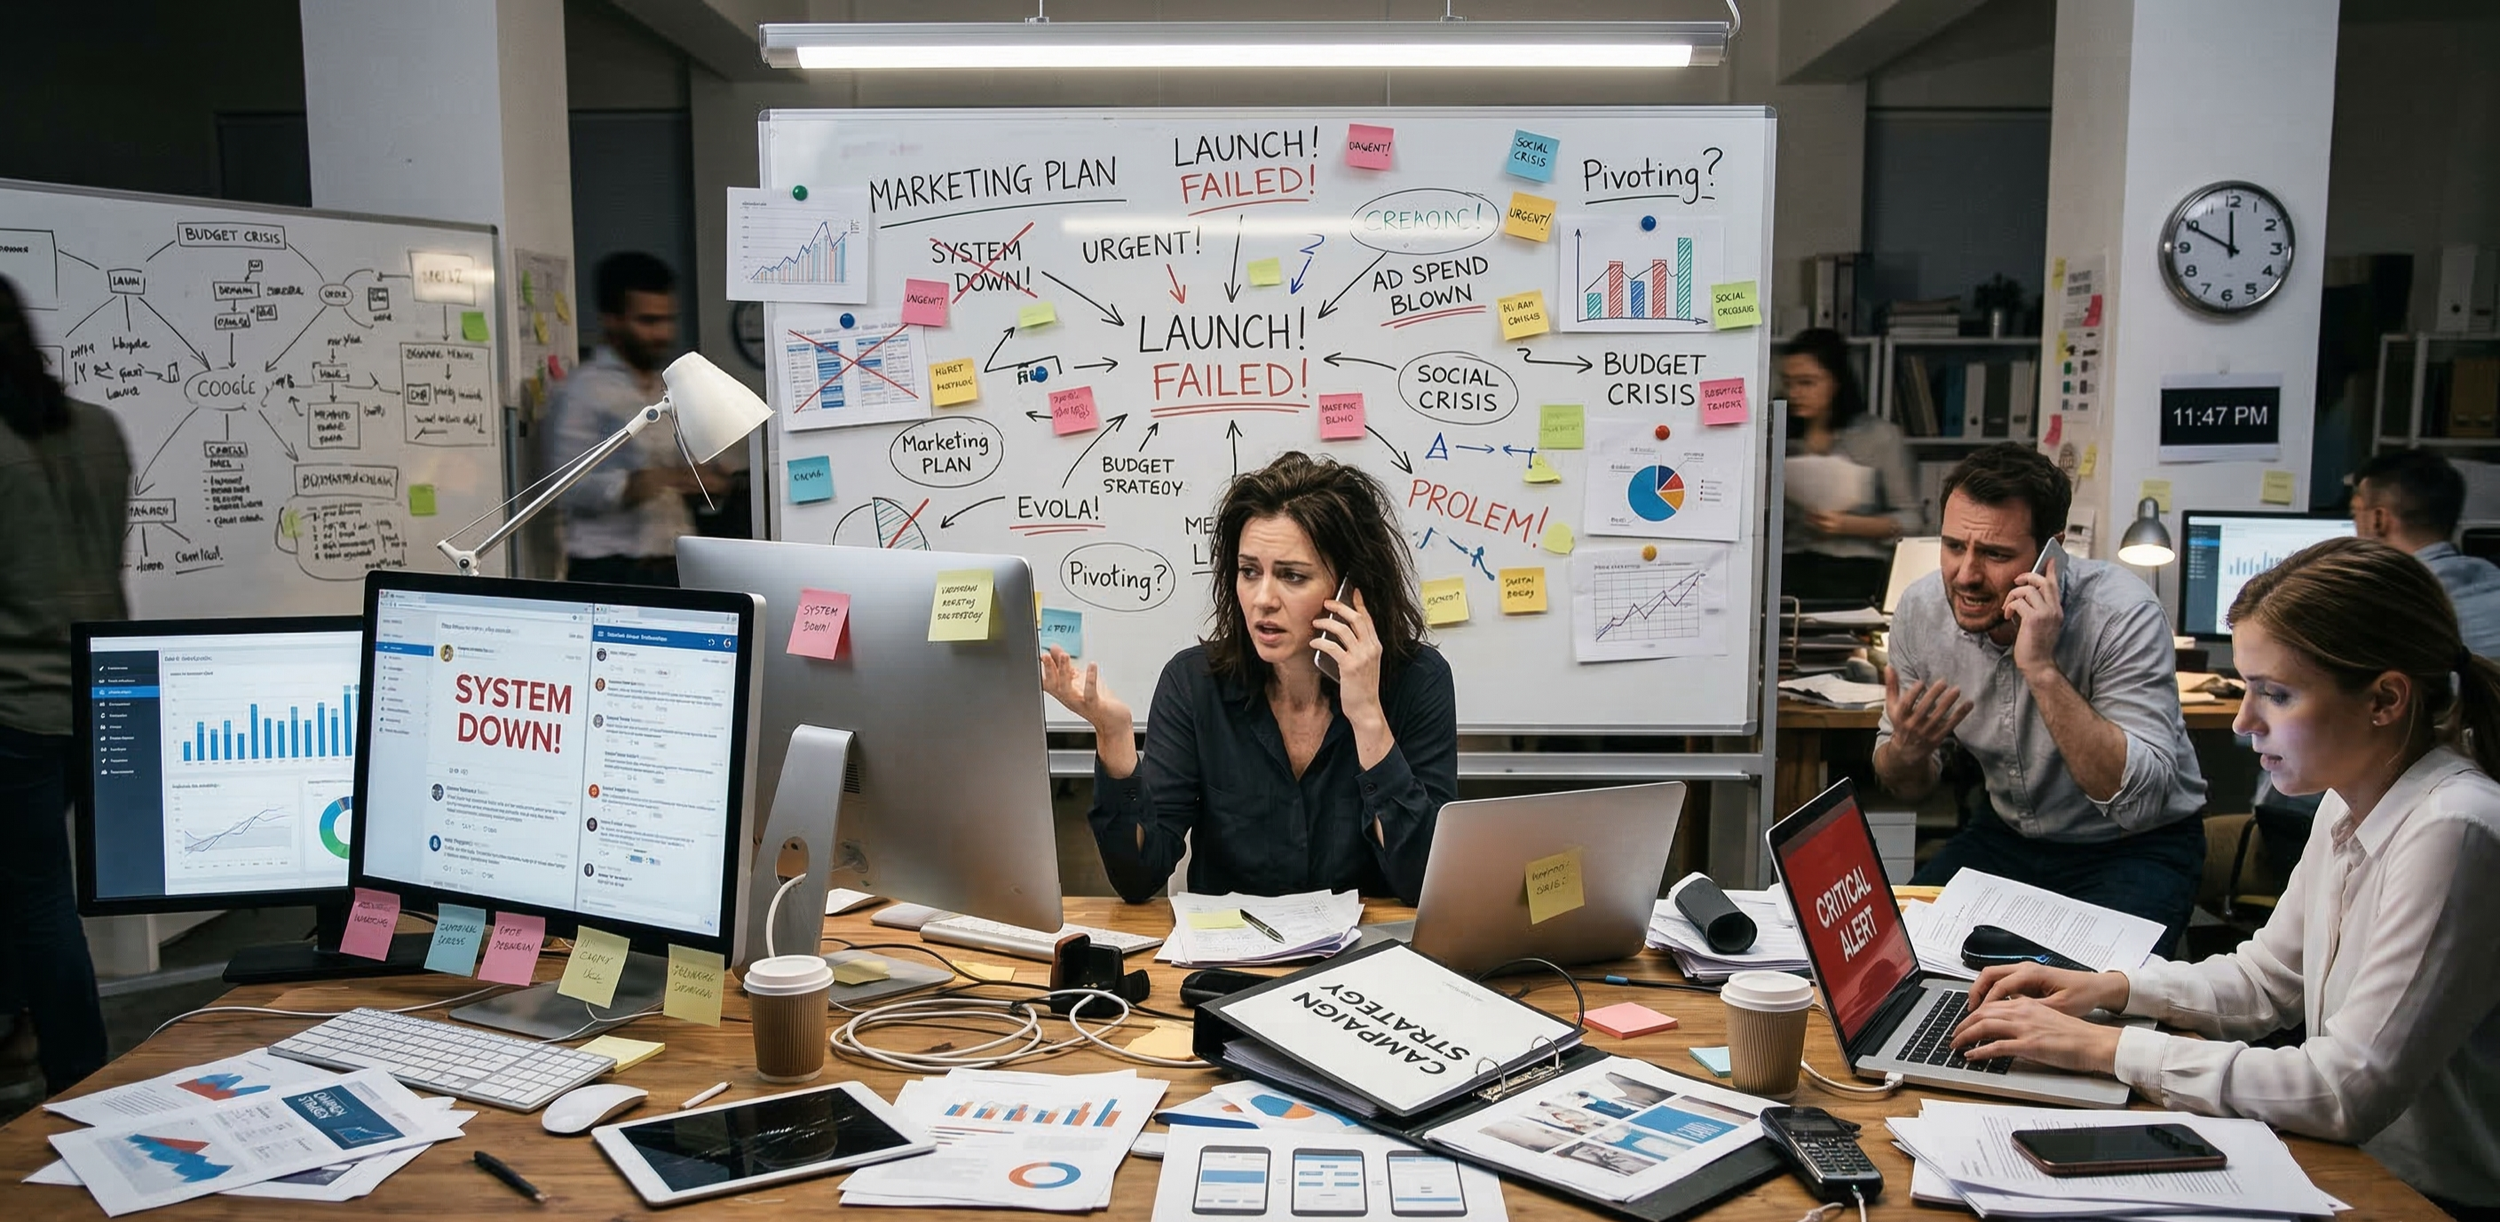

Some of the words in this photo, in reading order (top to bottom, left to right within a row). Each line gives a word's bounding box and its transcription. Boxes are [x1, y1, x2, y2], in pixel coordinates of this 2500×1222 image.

[1175, 125, 1319, 168] LAUNCH!
[1515, 136, 1548, 155] SOCIAL
[1513, 151, 1546, 168] CRISIS
[869, 163, 1033, 214] MARKETING
[1045, 156, 1118, 192] PLAN
[1181, 164, 1317, 203] FAILED!
[1583, 147, 1724, 205] Pivoting?
[2226, 195, 2241, 208] 12
[1509, 207, 1552, 231] URGENT!
[2264, 219, 2278, 231] 2
[185, 227, 238, 241] BUDGET
[244, 232, 281, 244] CRISIS
[1082, 226, 1202, 264] URGENT!
[2178, 242, 2191, 253] 9
[931, 241, 1022, 264] SYSTEM
[2269, 243, 2282, 255] 3
[955, 267, 1031, 293] DOWN!
[1372, 268, 1404, 292] AD
[1413, 255, 1490, 287] SPEND
[2184, 265, 2197, 277] 8
[2262, 265, 2273, 276] 4
[1391, 283, 1473, 316] BLOWN
[1715, 292, 1745, 304] SOCIAL
[2201, 283, 2211, 295] 7
[2221, 289, 2233, 301] 6
[2245, 283, 2257, 295] 5
[1140, 307, 1306, 353] LAUNCH!
[1417, 364, 1499, 388] SOCIAL
[1604, 352, 1707, 377] BUDGET
[1154, 358, 1310, 398] FAILED!
[1419, 389, 1498, 412] CRISIS
[1607, 382, 1696, 407] CRISIS
[2173, 406, 2228, 426] 11:47
[2235, 405, 2267, 425] PM
[903, 433, 990, 458] Marketing
[922, 458, 972, 473] PLAN
[1102, 455, 1175, 474] BUDGET
[1018, 496, 1100, 521] EVOLA!
[1408, 478, 1549, 549] PROLEM!
[1070, 561, 1168, 601] Pivoting?
[803, 605, 839, 617] SYSTEM
[454, 673, 573, 715] SYSTEM
[456, 712, 561, 755] DOWN!
[1815, 864, 1873, 930] CRITICAL
[1839, 904, 1878, 963] ALERT
[1292, 991, 1447, 1075] CAMPAIGN
[1319, 983, 1471, 1062] STRATEGY
